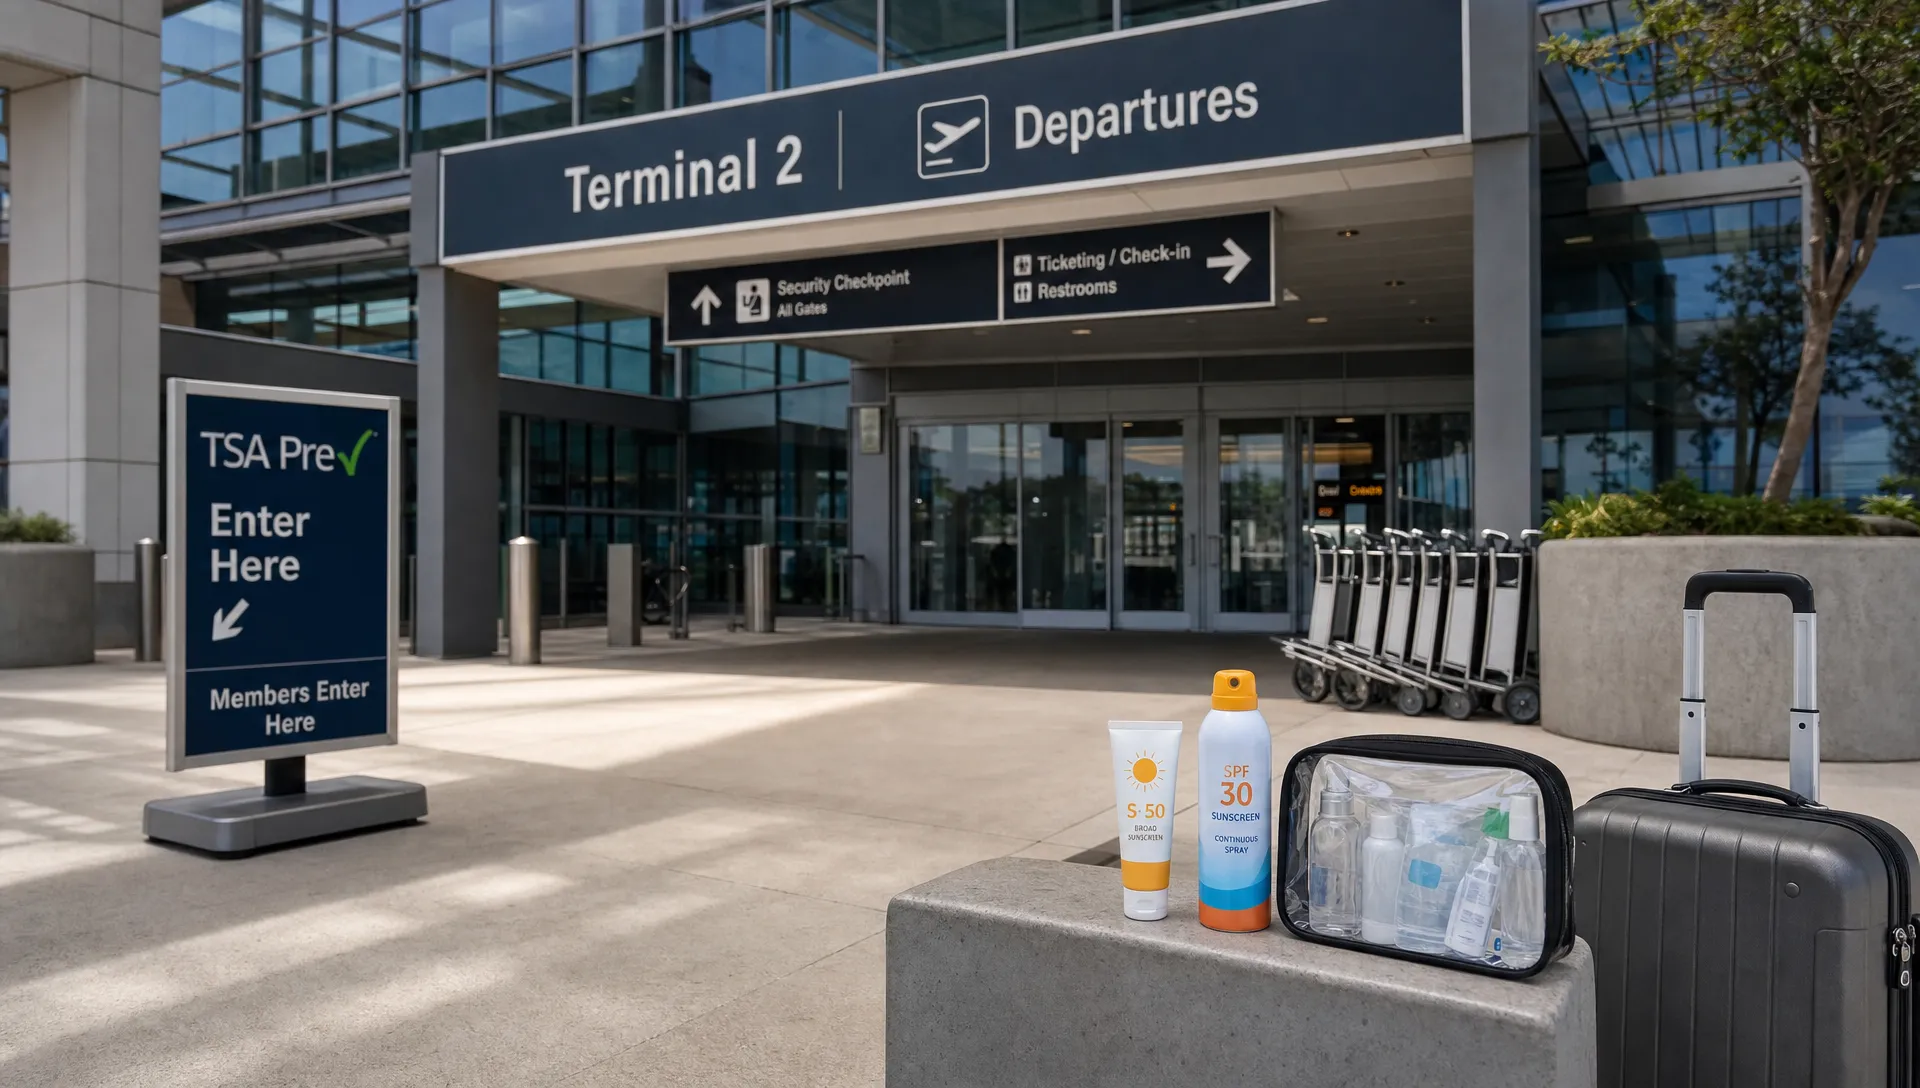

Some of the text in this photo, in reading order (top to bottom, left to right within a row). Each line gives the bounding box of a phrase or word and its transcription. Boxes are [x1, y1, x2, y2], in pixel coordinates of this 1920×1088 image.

[1015, 81, 1260, 155] Departures
[565, 135, 803, 214] Terminal 2
[1037, 243, 1191, 272] Ticketing / Check-in
[777, 269, 911, 296] Security Checkpoint
[1037, 280, 1118, 300] Restrooms
[777, 301, 828, 318] All Gates
[200, 431, 336, 472] TSA Pre
[210, 502, 311, 538] Enter
[211, 548, 301, 583] Here
[210, 679, 370, 711] Members Enter
[265, 713, 316, 736] Here
[1224, 764, 1250, 778] SPF
[1220, 781, 1253, 807] 30
[1134, 824, 1157, 832] BROAD
[1211, 811, 1261, 822] SUNSCREEN
[1214, 834, 1259, 844] CONTINUOUS
[1224, 845, 1249, 854] SPRAY
